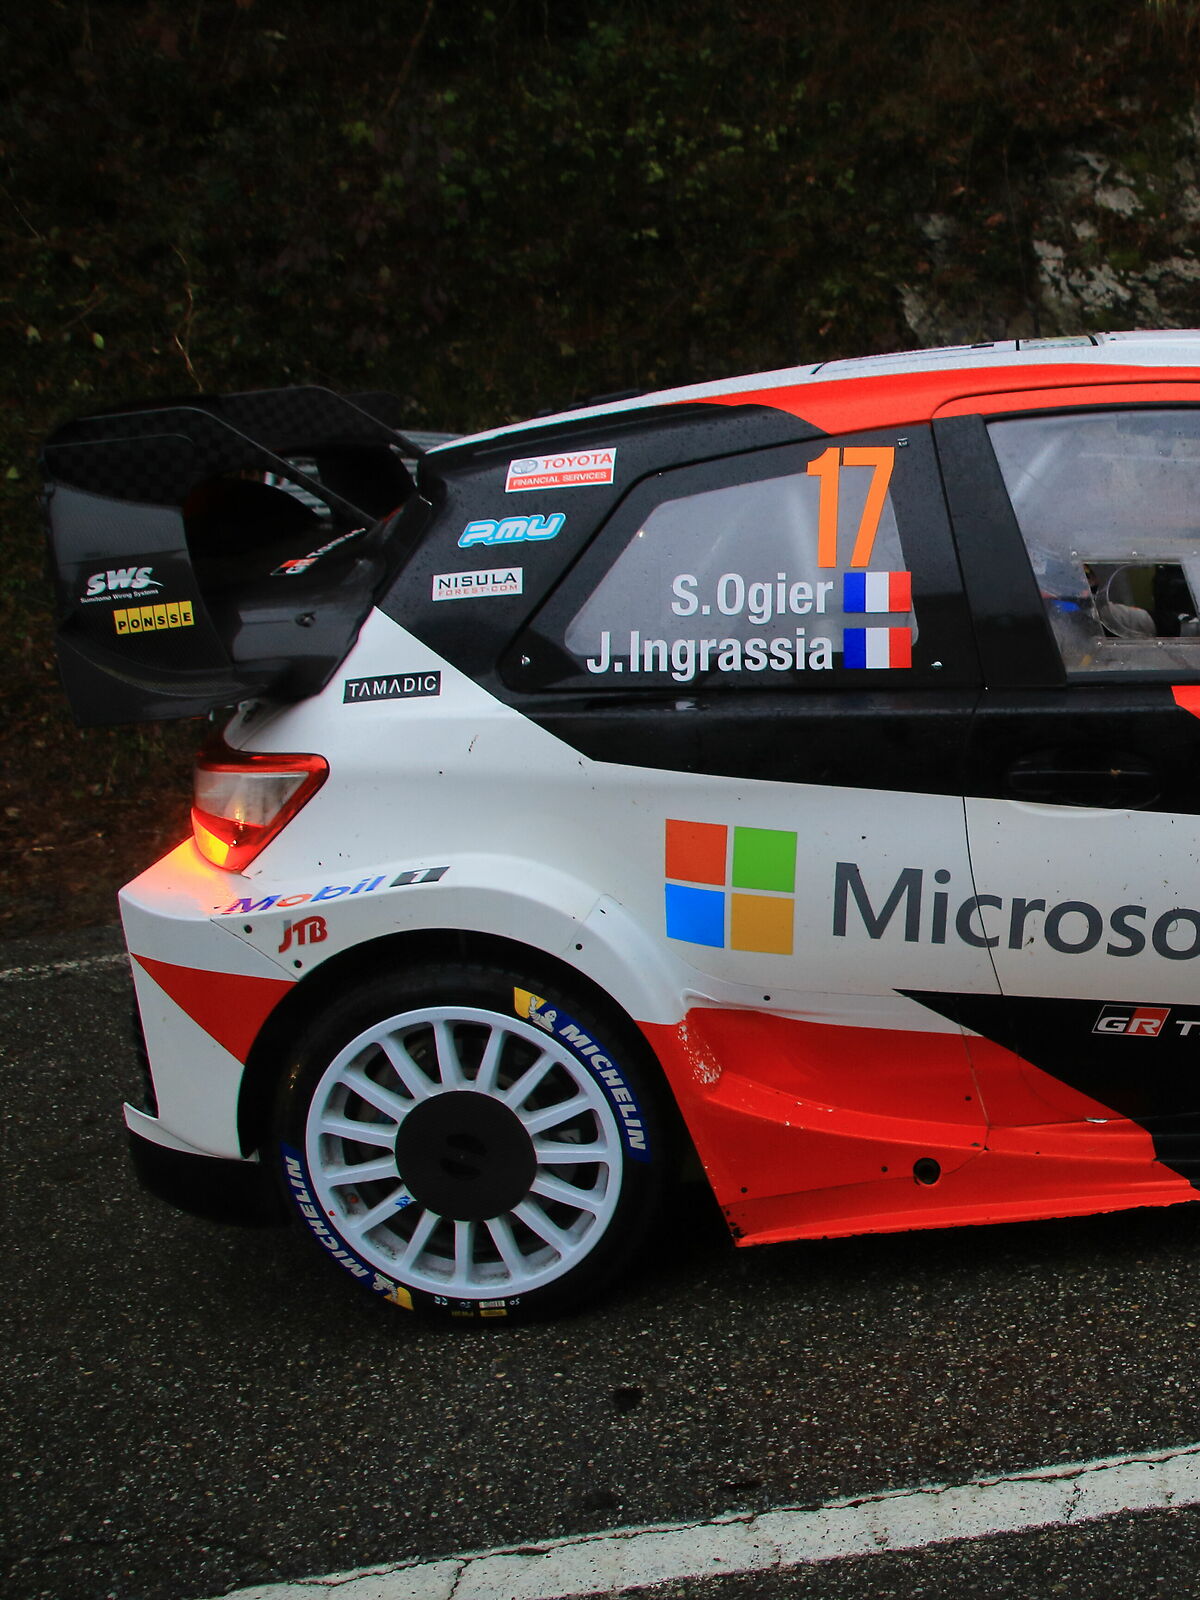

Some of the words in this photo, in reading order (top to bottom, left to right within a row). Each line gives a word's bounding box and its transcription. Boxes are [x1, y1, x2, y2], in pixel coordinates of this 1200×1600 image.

[542, 453, 613, 470] TOYOTA
[512, 475, 560, 487] FINANCIAL
[562, 471, 607, 483] SERVICES
[806, 446, 895, 569] 17
[86, 567, 158, 597] SWS
[438, 572, 517, 590] NISULA
[671, 572, 834, 625] S.Ogier
[117, 611, 192, 631] PONSSE
[586, 627, 834, 682] J.Ingrassia
[348, 675, 437, 698] TAMADIC
[221, 876, 386, 915] Mobil
[278, 915, 328, 954] JTB
[1096, 1016, 1160, 1036] GR
[558, 1024, 646, 1150] MICHELIN
[285, 1155, 370, 1278] MICHELIN
